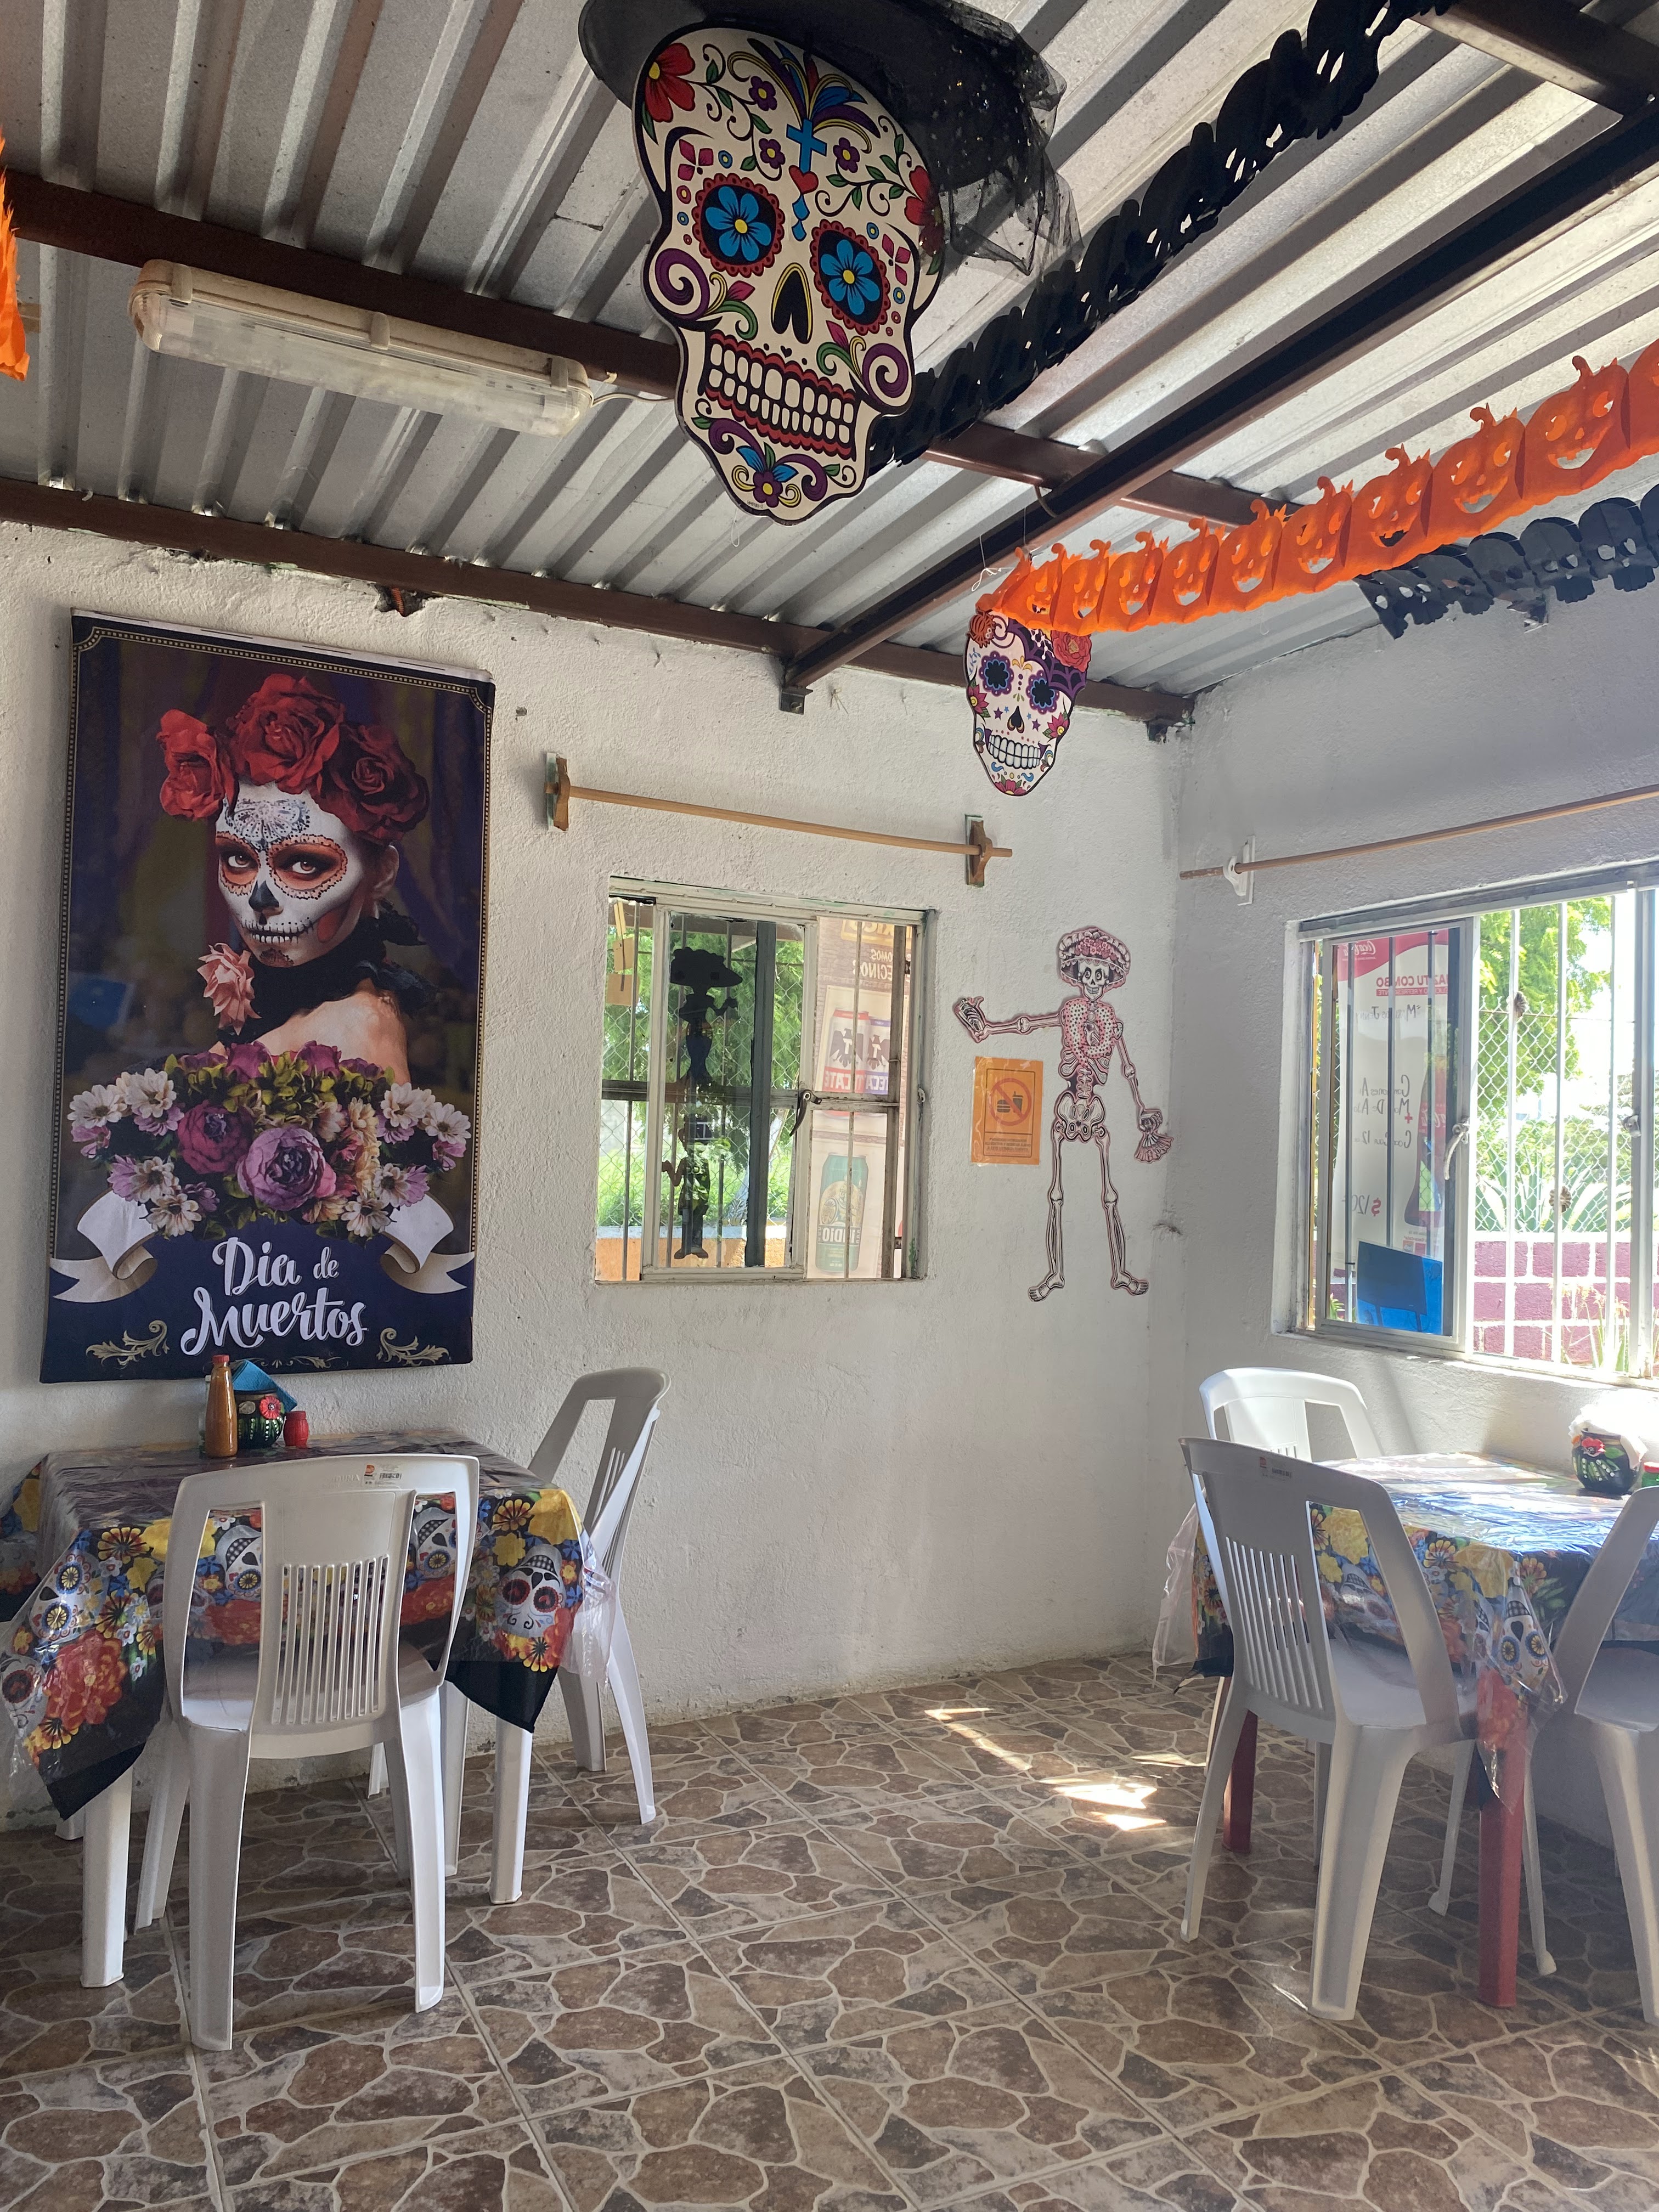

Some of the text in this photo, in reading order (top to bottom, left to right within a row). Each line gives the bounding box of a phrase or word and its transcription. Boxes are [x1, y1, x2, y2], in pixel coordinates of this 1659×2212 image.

[212, 1237, 339, 1296] Dia de
[180, 1287, 369, 1356] Muertos
